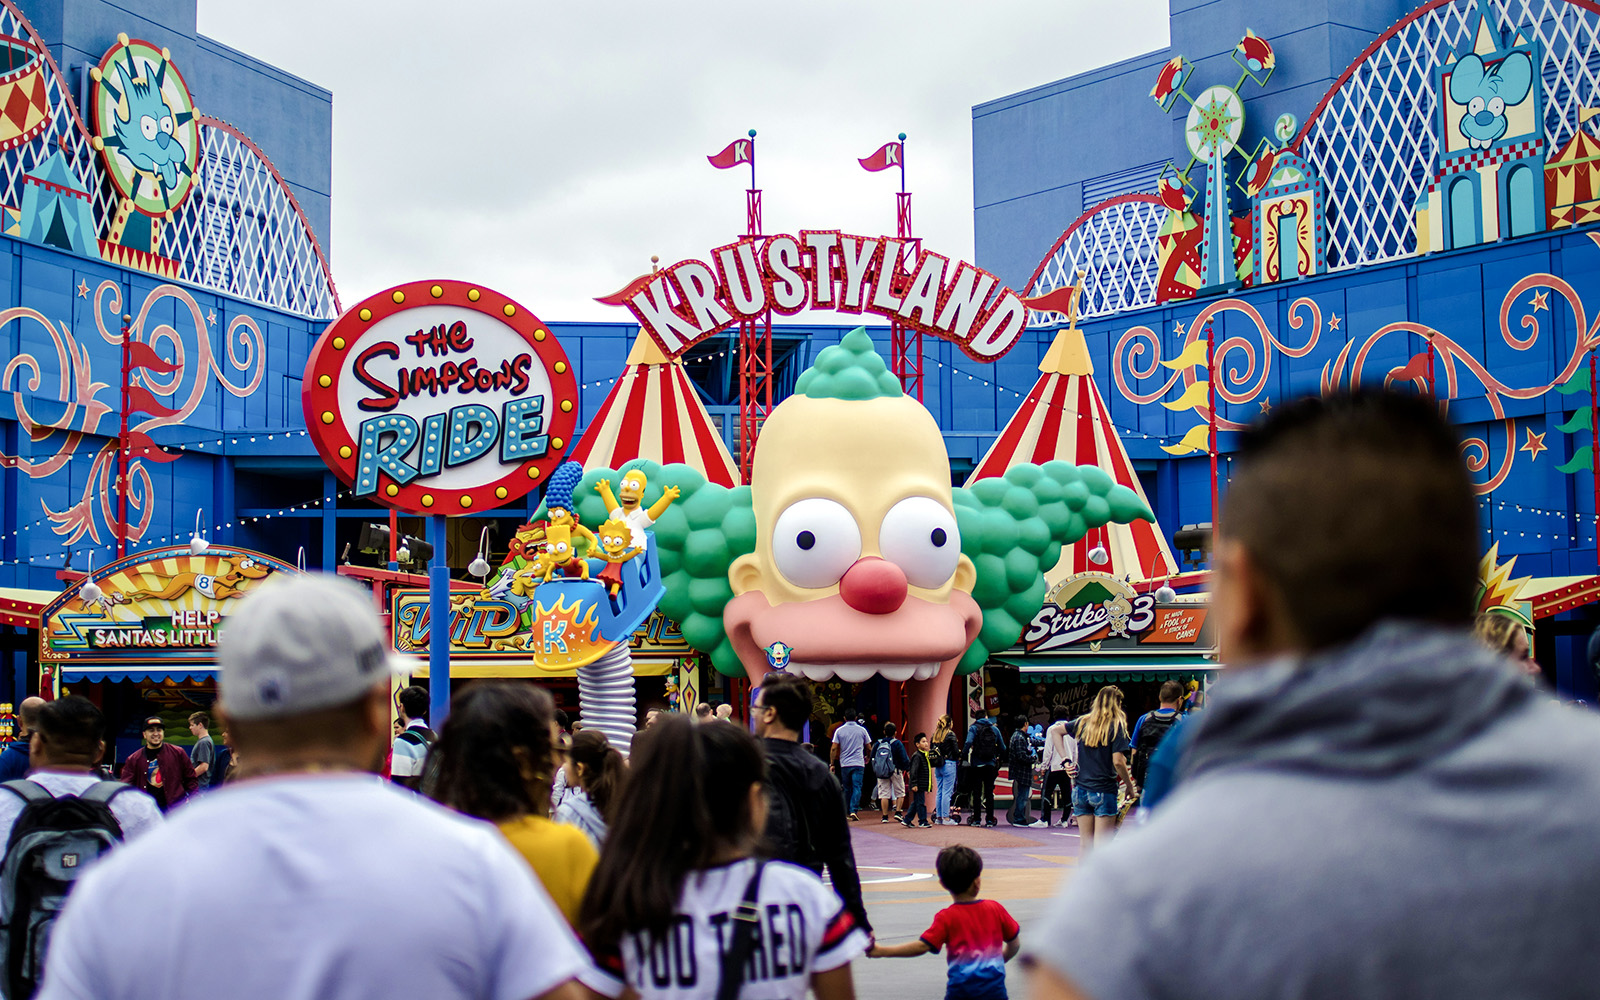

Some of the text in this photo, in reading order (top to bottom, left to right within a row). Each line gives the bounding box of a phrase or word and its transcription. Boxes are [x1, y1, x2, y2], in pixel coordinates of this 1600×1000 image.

[735, 141, 749, 162] K
[885, 144, 899, 165] K
[627, 231, 1028, 361] KRUSTYLAND
[352, 395, 550, 499] RIDE
[199, 576, 209, 589] 8
[171, 609, 220, 628] HELP
[1025, 596, 1155, 643] Strike 3
[1164, 618, 1180, 628] FOOL
[94, 628, 167, 646] SANTA'S
[543, 620, 569, 654] K
[1176, 628, 1196, 640] CANS!
[1052, 682, 1088, 707] SWING
[709, 903, 807, 985] TRED
